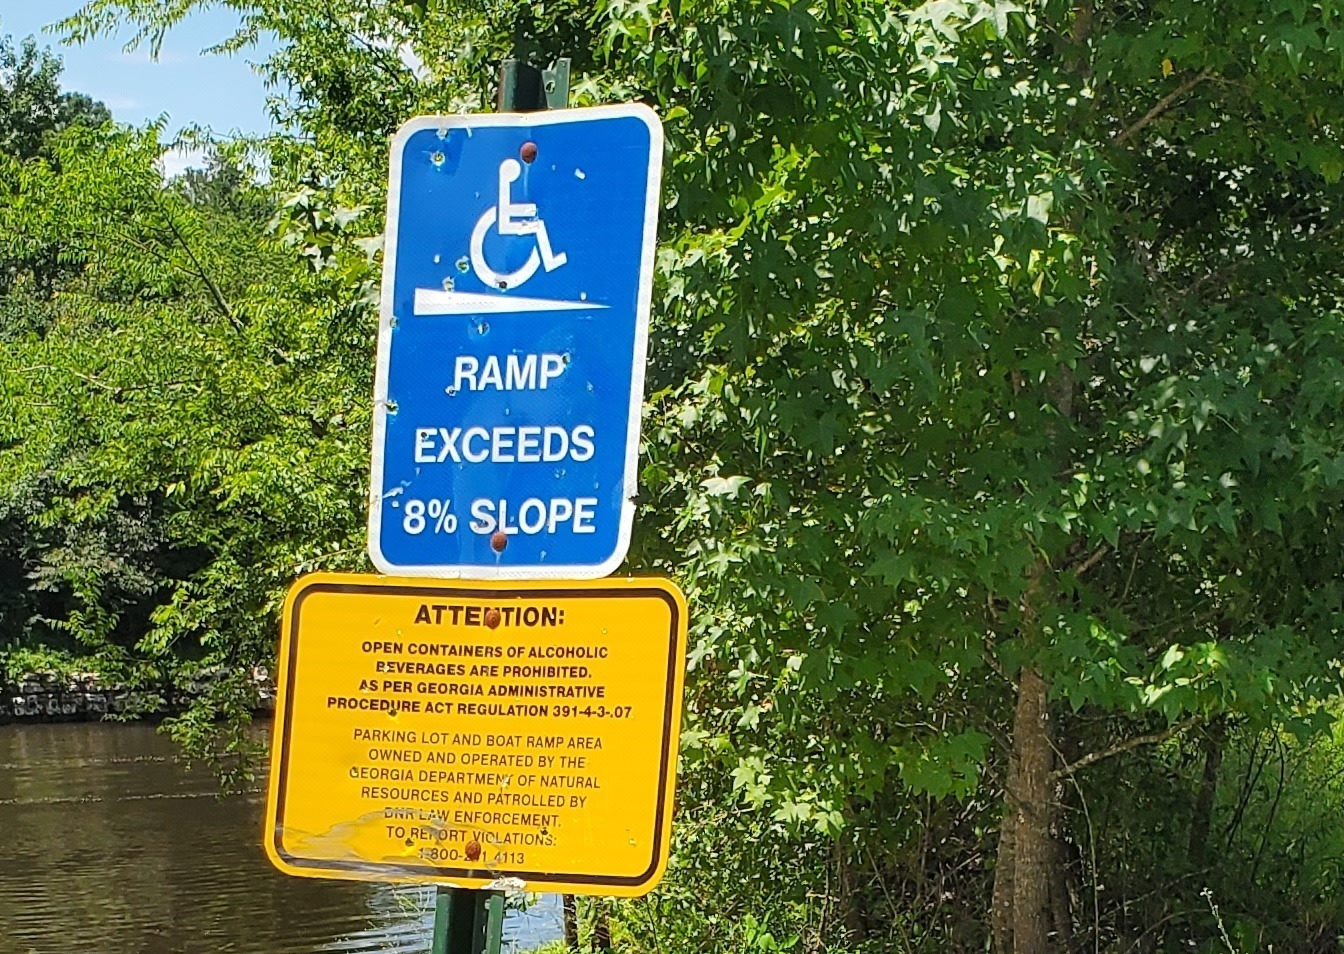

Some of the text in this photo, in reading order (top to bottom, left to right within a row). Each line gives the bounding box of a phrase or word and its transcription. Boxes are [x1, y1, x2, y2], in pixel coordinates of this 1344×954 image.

[453, 354, 565, 391] RAMP
[414, 425, 595, 463] EXCEEDS
[403, 498, 598, 535] 8% SLOPE
[362, 641, 608, 659] OPEN CONTAINERS OF ALCOHOLIC
[376, 660, 592, 679] BEVERAGES ARE PROHIBITED.
[359, 679, 606, 698] AS PER GEORGIA ADMINISTRATIVE
[327, 696, 633, 719] PROCEDURE ACT REGULATION 391-4-3-.07
[353, 728, 603, 750] PARKING LOT AND BOAT RAMP AREA
[368, 748, 586, 769] OWNED AND OPERATED BY THE
[349, 766, 601, 789] GEORGIA DEPARTMENT OF NATURAL
[361, 786, 587, 808] RESOURCES AND PATROLLED BY
[384, 807, 562, 827] DNR LAW ENFORCEMENT.
[386, 826, 406, 839] TO
[472, 830, 557, 847] VIOLATIONS:
